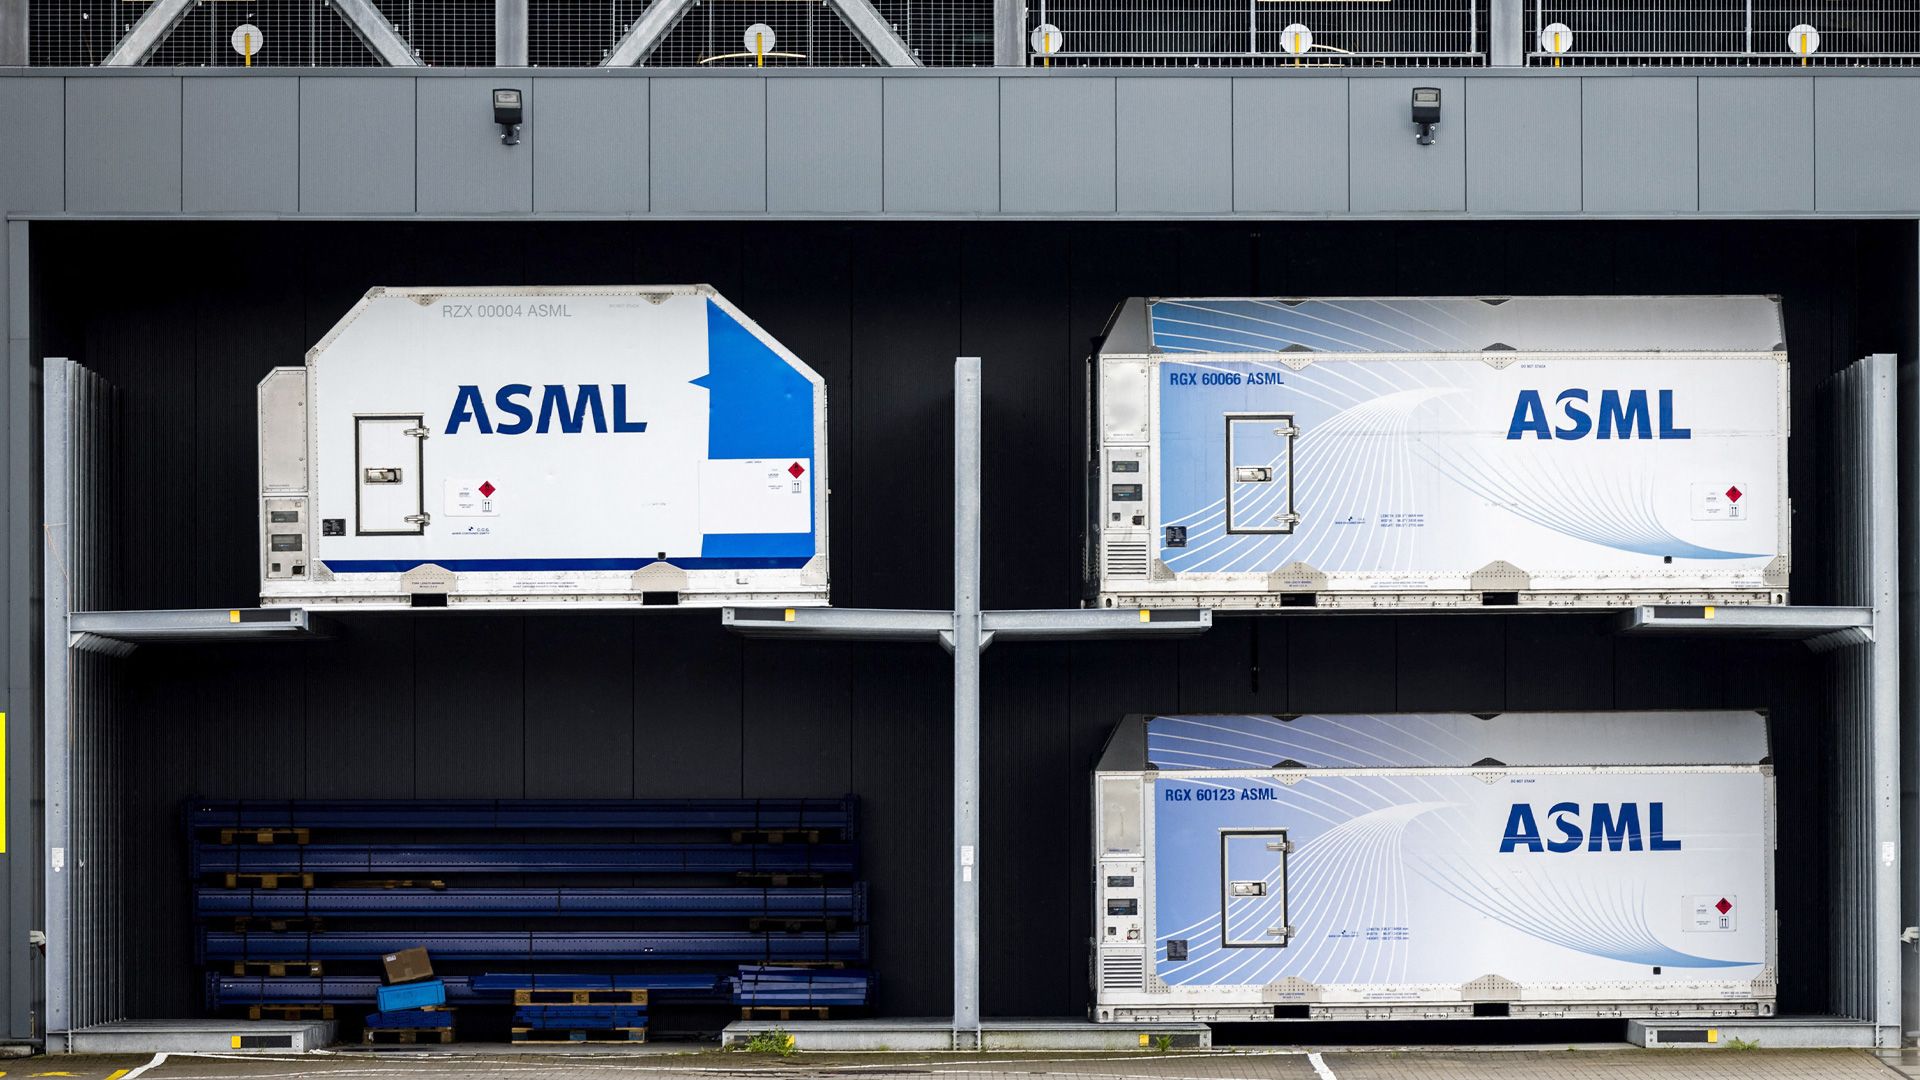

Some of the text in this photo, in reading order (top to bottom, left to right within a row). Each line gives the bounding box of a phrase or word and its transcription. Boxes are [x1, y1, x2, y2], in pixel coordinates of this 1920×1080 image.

[442, 304, 572, 318] RZX 00004 ASML
[1169, 372, 1285, 386] RGX 60066 ASML
[444, 383, 648, 436] ASML
[1506, 388, 1692, 441] ASML
[1164, 788, 1278, 802] RGX 60123 ASML
[1499, 801, 1682, 854] ASML
